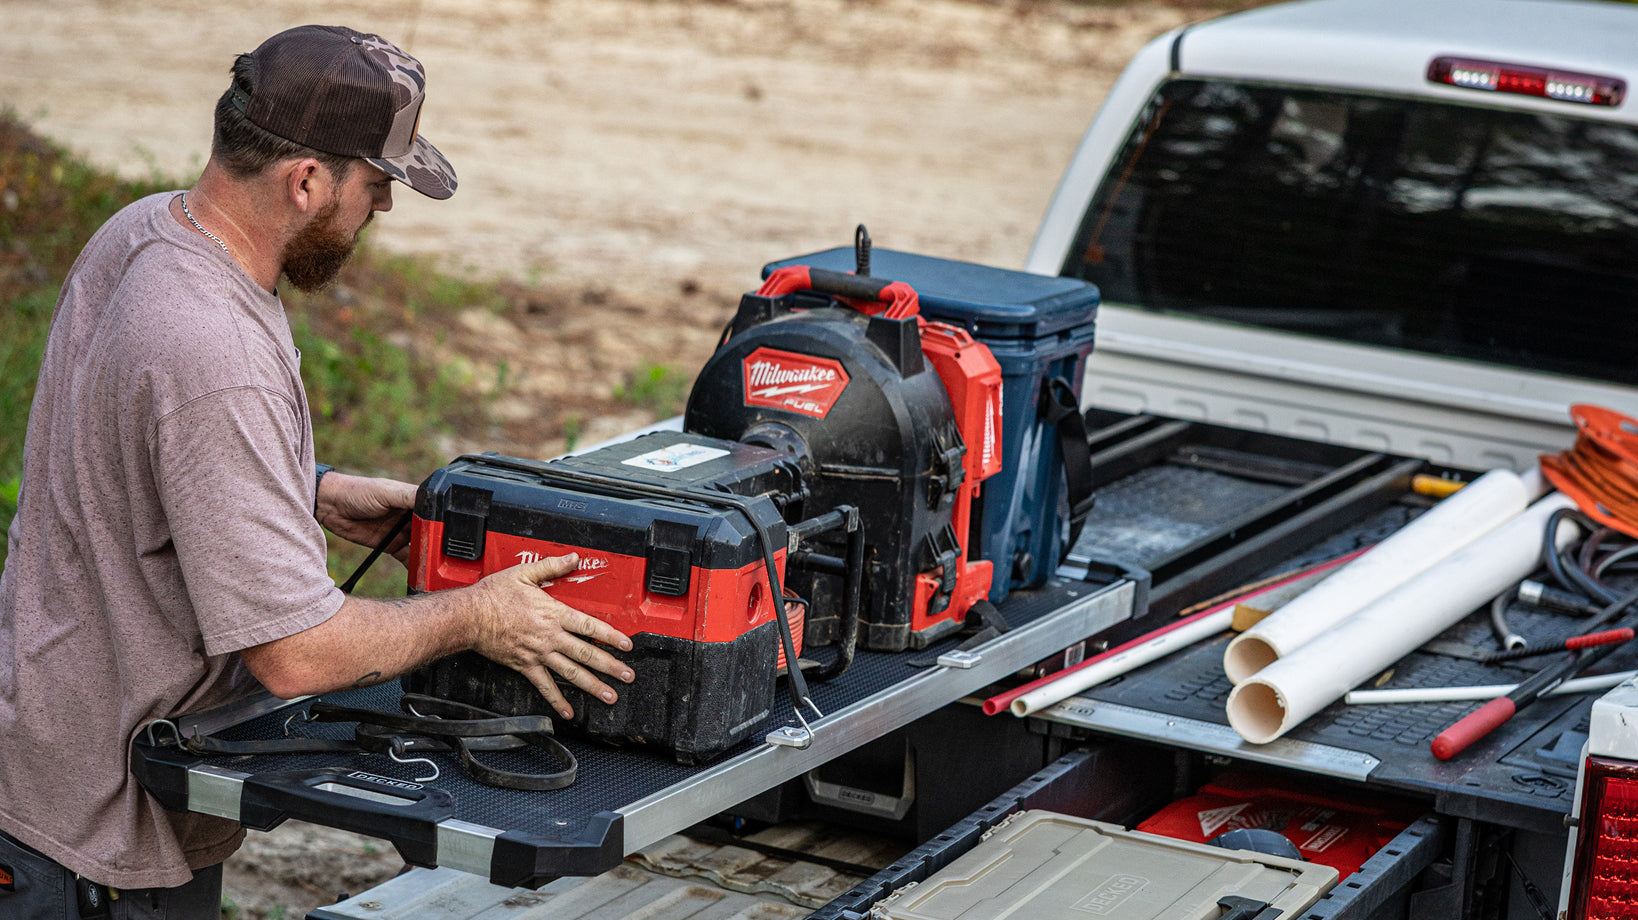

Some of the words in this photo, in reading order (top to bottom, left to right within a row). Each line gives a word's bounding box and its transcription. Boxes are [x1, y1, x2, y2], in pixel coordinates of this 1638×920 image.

[750, 360, 836, 387] Milwaukee
[783, 398, 824, 414] FUEL
[356, 774, 418, 790] DECKED
[1081, 877, 1140, 911] DECKED
